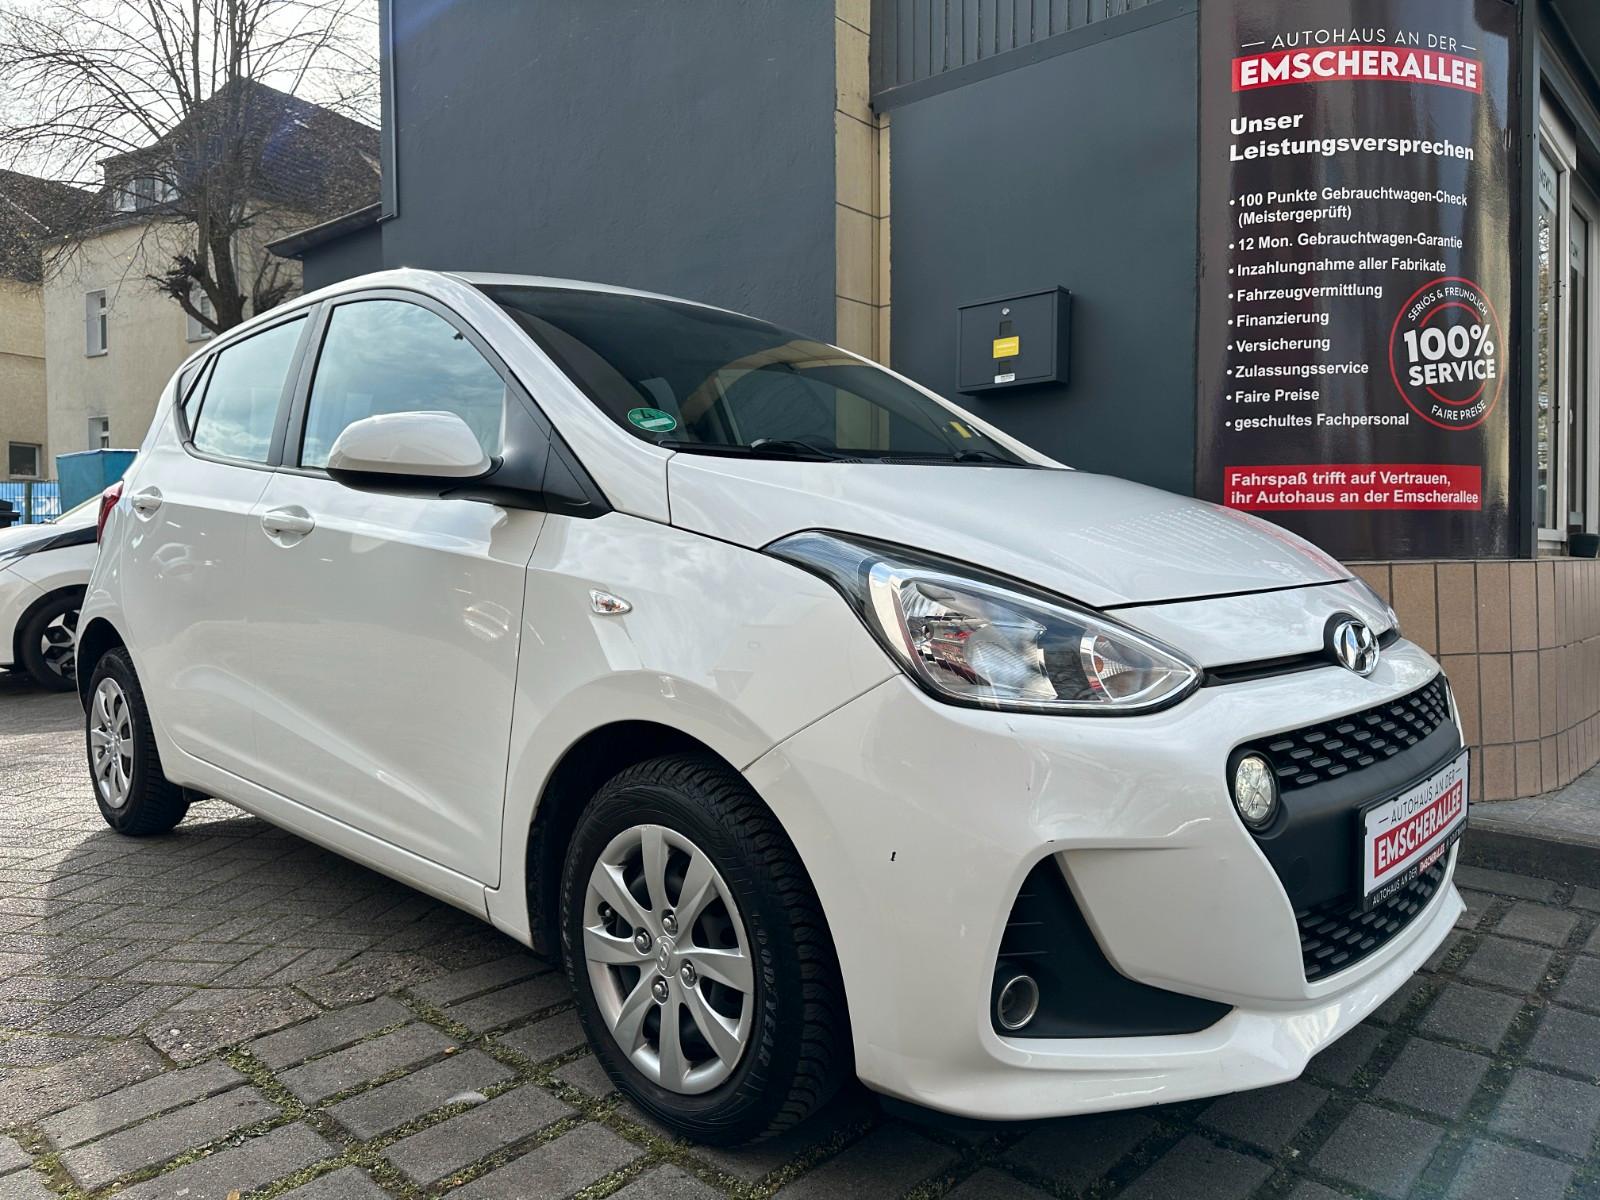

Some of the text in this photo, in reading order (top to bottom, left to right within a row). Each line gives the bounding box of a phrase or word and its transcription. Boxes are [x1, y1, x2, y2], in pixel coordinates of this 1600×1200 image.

[1272, 28, 1457, 52] AUTOHAUS AN DER
[1241, 50, 1477, 88] EMSCHERALLEE
[1230, 113, 1303, 135] Unser
[1230, 137, 1474, 162] Leistungsversprechen
[1239, 187, 1468, 207] 100 Punkte Gebrauchtwagen-Check
[1238, 205, 1352, 228] (Meistergeprüft)
[1238, 231, 1463, 250] 12 Mon. Gebrauchtwagen-Garantie
[1237, 257, 1446, 276] Inzahlungnahme aller Fabrikate
[1237, 284, 1383, 301] Fahrzeugvermittlung
[1408, 294, 1436, 321] SERIÖS
[1445, 287, 1488, 316] FREUNDLICH
[1236, 311, 1329, 327] Finanzierung
[1236, 337, 1330, 353] Versicherung
[1404, 324, 1494, 362] 100%
[1235, 362, 1369, 378] Zulassungsservice
[1408, 359, 1496, 386] SERVICE
[1235, 388, 1320, 403] Faire Preise
[1431, 400, 1487, 420] FAIRE PREISE
[1234, 413, 1409, 431] geschultes Fachpersonal
[1231, 471, 1451, 488] Fahrspaß trifft auf Vertrauen,
[1231, 490, 1478, 504] ihr Autohaus an der Emscherallee
[1391, 786, 1433, 825] AUTOHAUS
[1435, 777, 1444, 796] AN
[1378, 784, 1462, 871] EMSCHERALLEE
